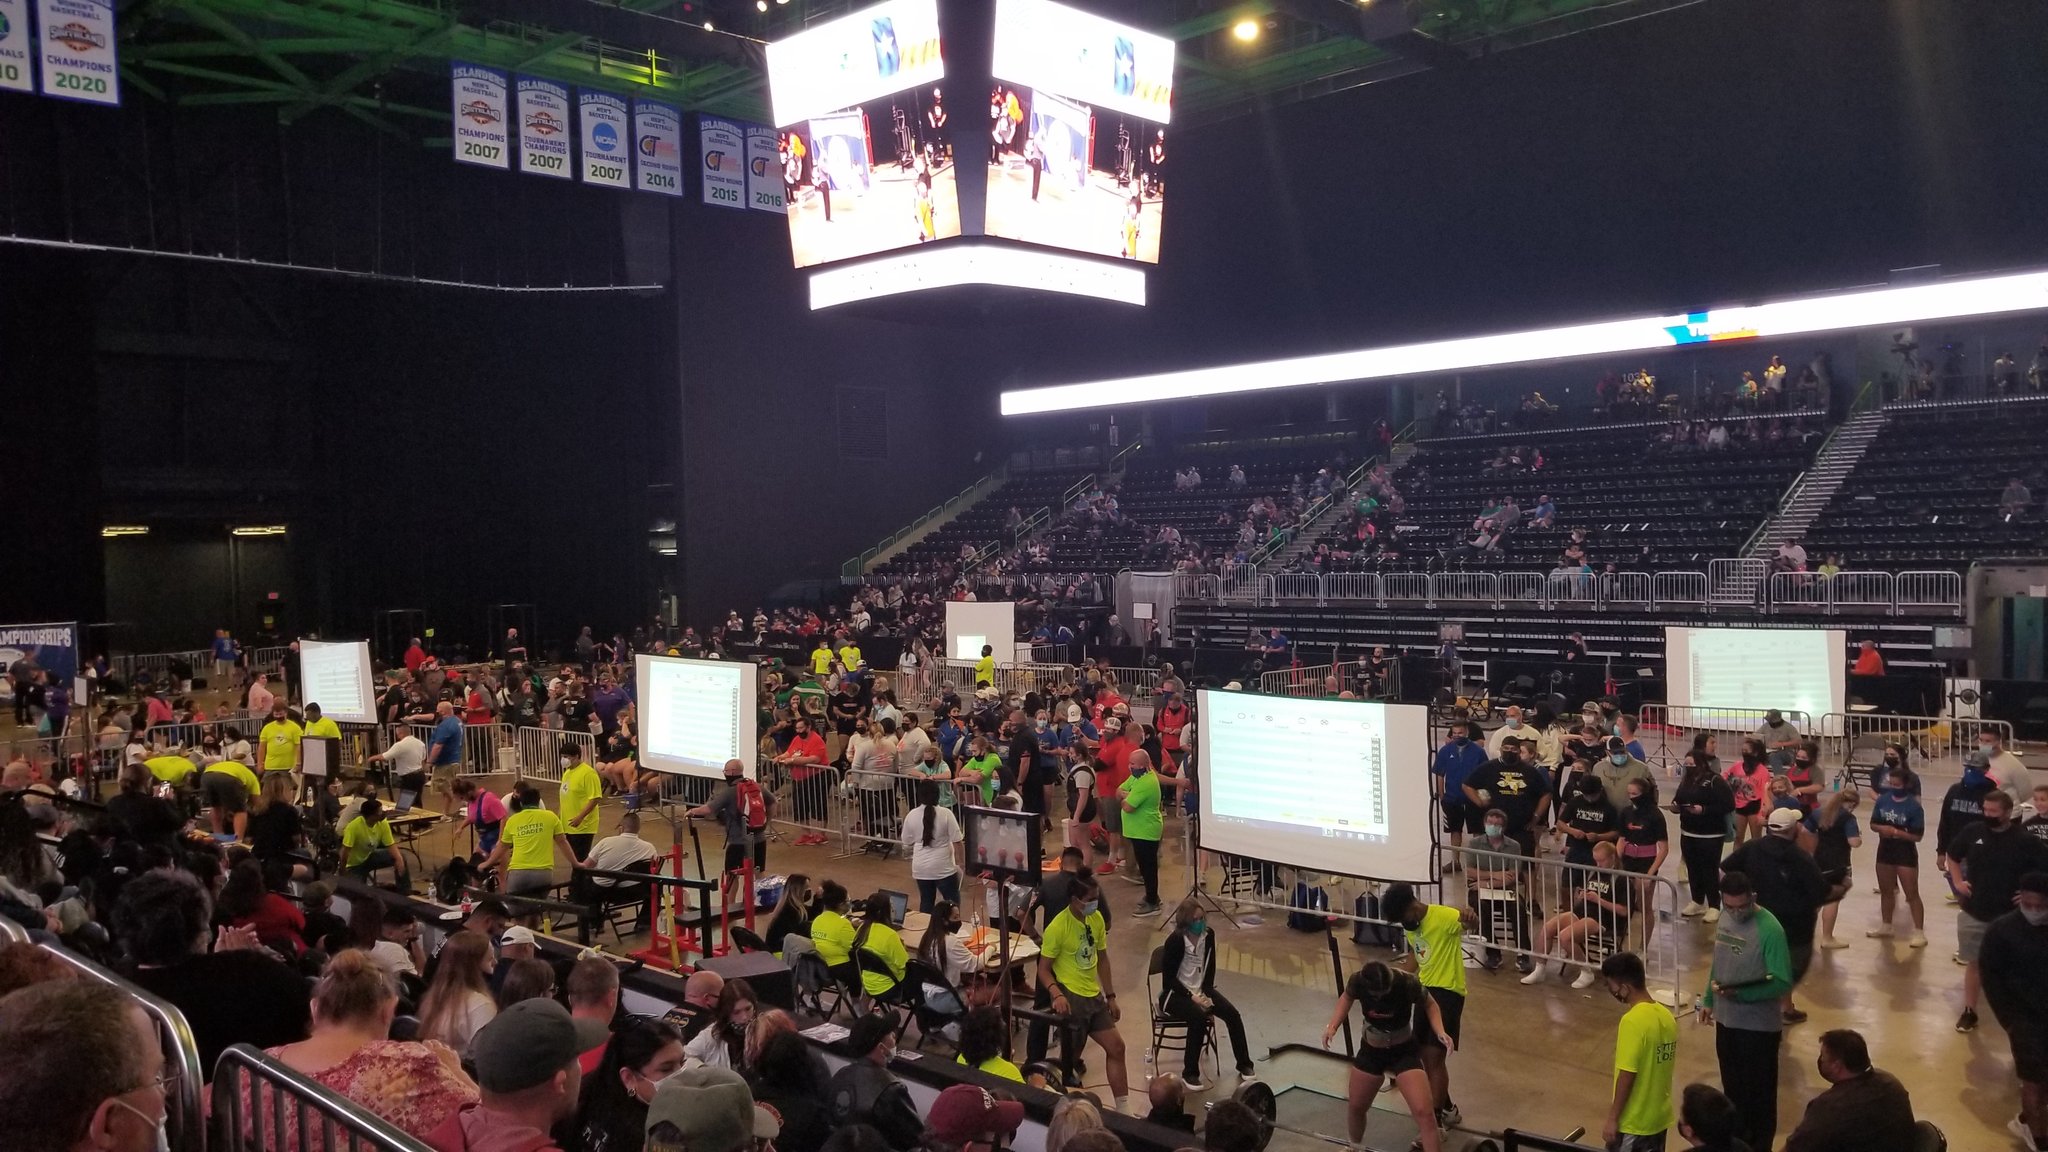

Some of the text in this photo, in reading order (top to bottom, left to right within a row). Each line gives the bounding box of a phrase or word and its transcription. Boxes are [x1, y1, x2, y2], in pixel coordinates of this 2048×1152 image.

[47, 54, 113, 73] CHAMPIONS
[56, 72, 107, 94] 2020
[453, 67, 507, 88] ISLANDERS
[462, 86, 498, 98] BASKETBALL
[518, 80, 567, 100] ISLANDERS
[526, 98, 560, 110] BASKETBALL
[580, 94, 627, 112] ISLANDERS
[588, 111, 620, 122] BASKETBALL
[635, 103, 680, 120] ISLANDERS
[643, 121, 673, 132] BASKETBALL
[701, 120, 743, 137] ISLANDERS
[747, 127, 779, 141] ISLANDE
[458, 128, 505, 143] CHAMPIONS
[524, 136, 566, 147] TOURNAMENT
[464, 142, 500, 159] 2007
[525, 143, 567, 155] CHAMPIONS
[529, 153, 562, 170] 2007
[585, 151, 627, 164] TOURNAMENT
[591, 164, 623, 180] 2007
[646, 172, 675, 188] 2014
[711, 186, 738, 202] 2015
[756, 192, 782, 207] 2016
[0, 628, 71, 647] MPIONSHIPS
